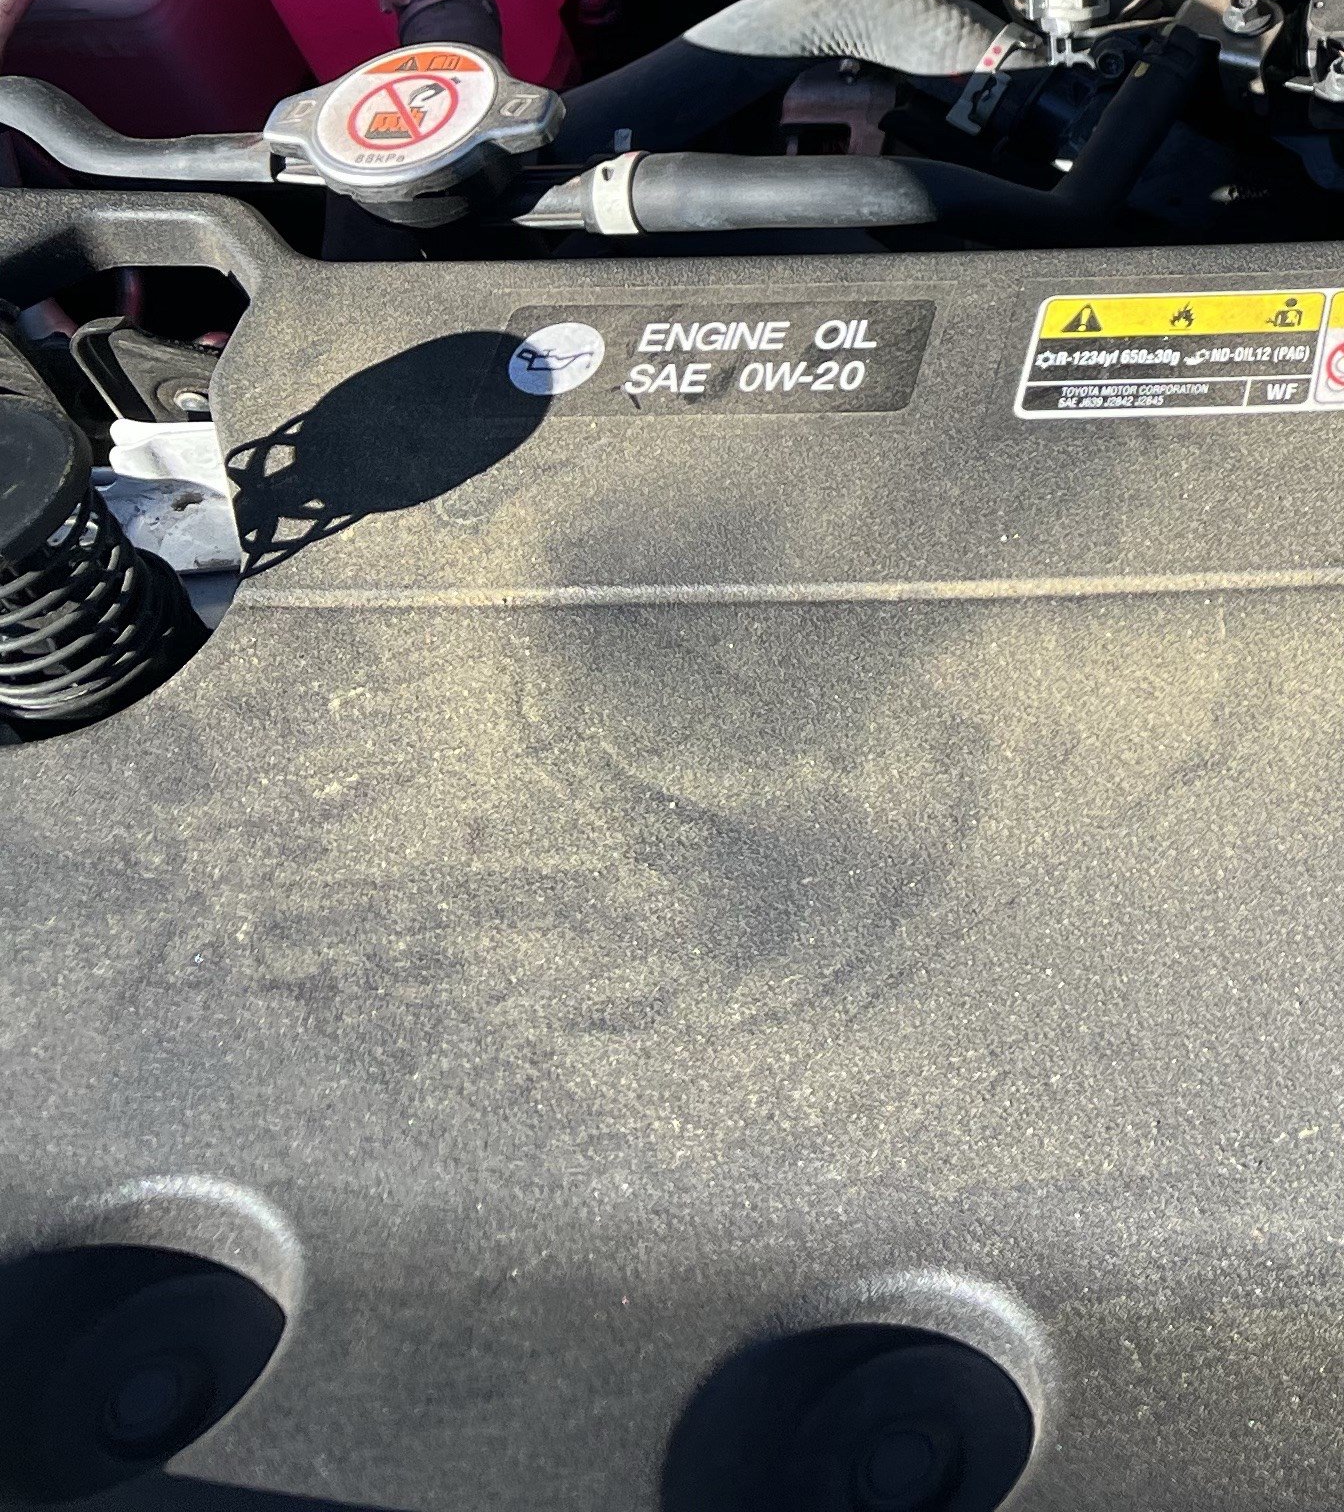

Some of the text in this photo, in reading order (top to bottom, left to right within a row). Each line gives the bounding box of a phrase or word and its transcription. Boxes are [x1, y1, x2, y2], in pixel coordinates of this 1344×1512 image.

[354, 152, 405, 164] 88kPa
[638, 320, 877, 353] ENGINE OIL
[1120, 348, 1181, 367] 650±30g
[1273, 345, 1311, 364] (PAG)
[624, 360, 866, 395] SAE 0W-20
[1061, 383, 1209, 397] TOYOTA MOTOR CORPORATION
[1266, 382, 1299, 401] WF
[1058, 396, 1078, 408] SAE
[1079, 396, 1104, 408] J639
